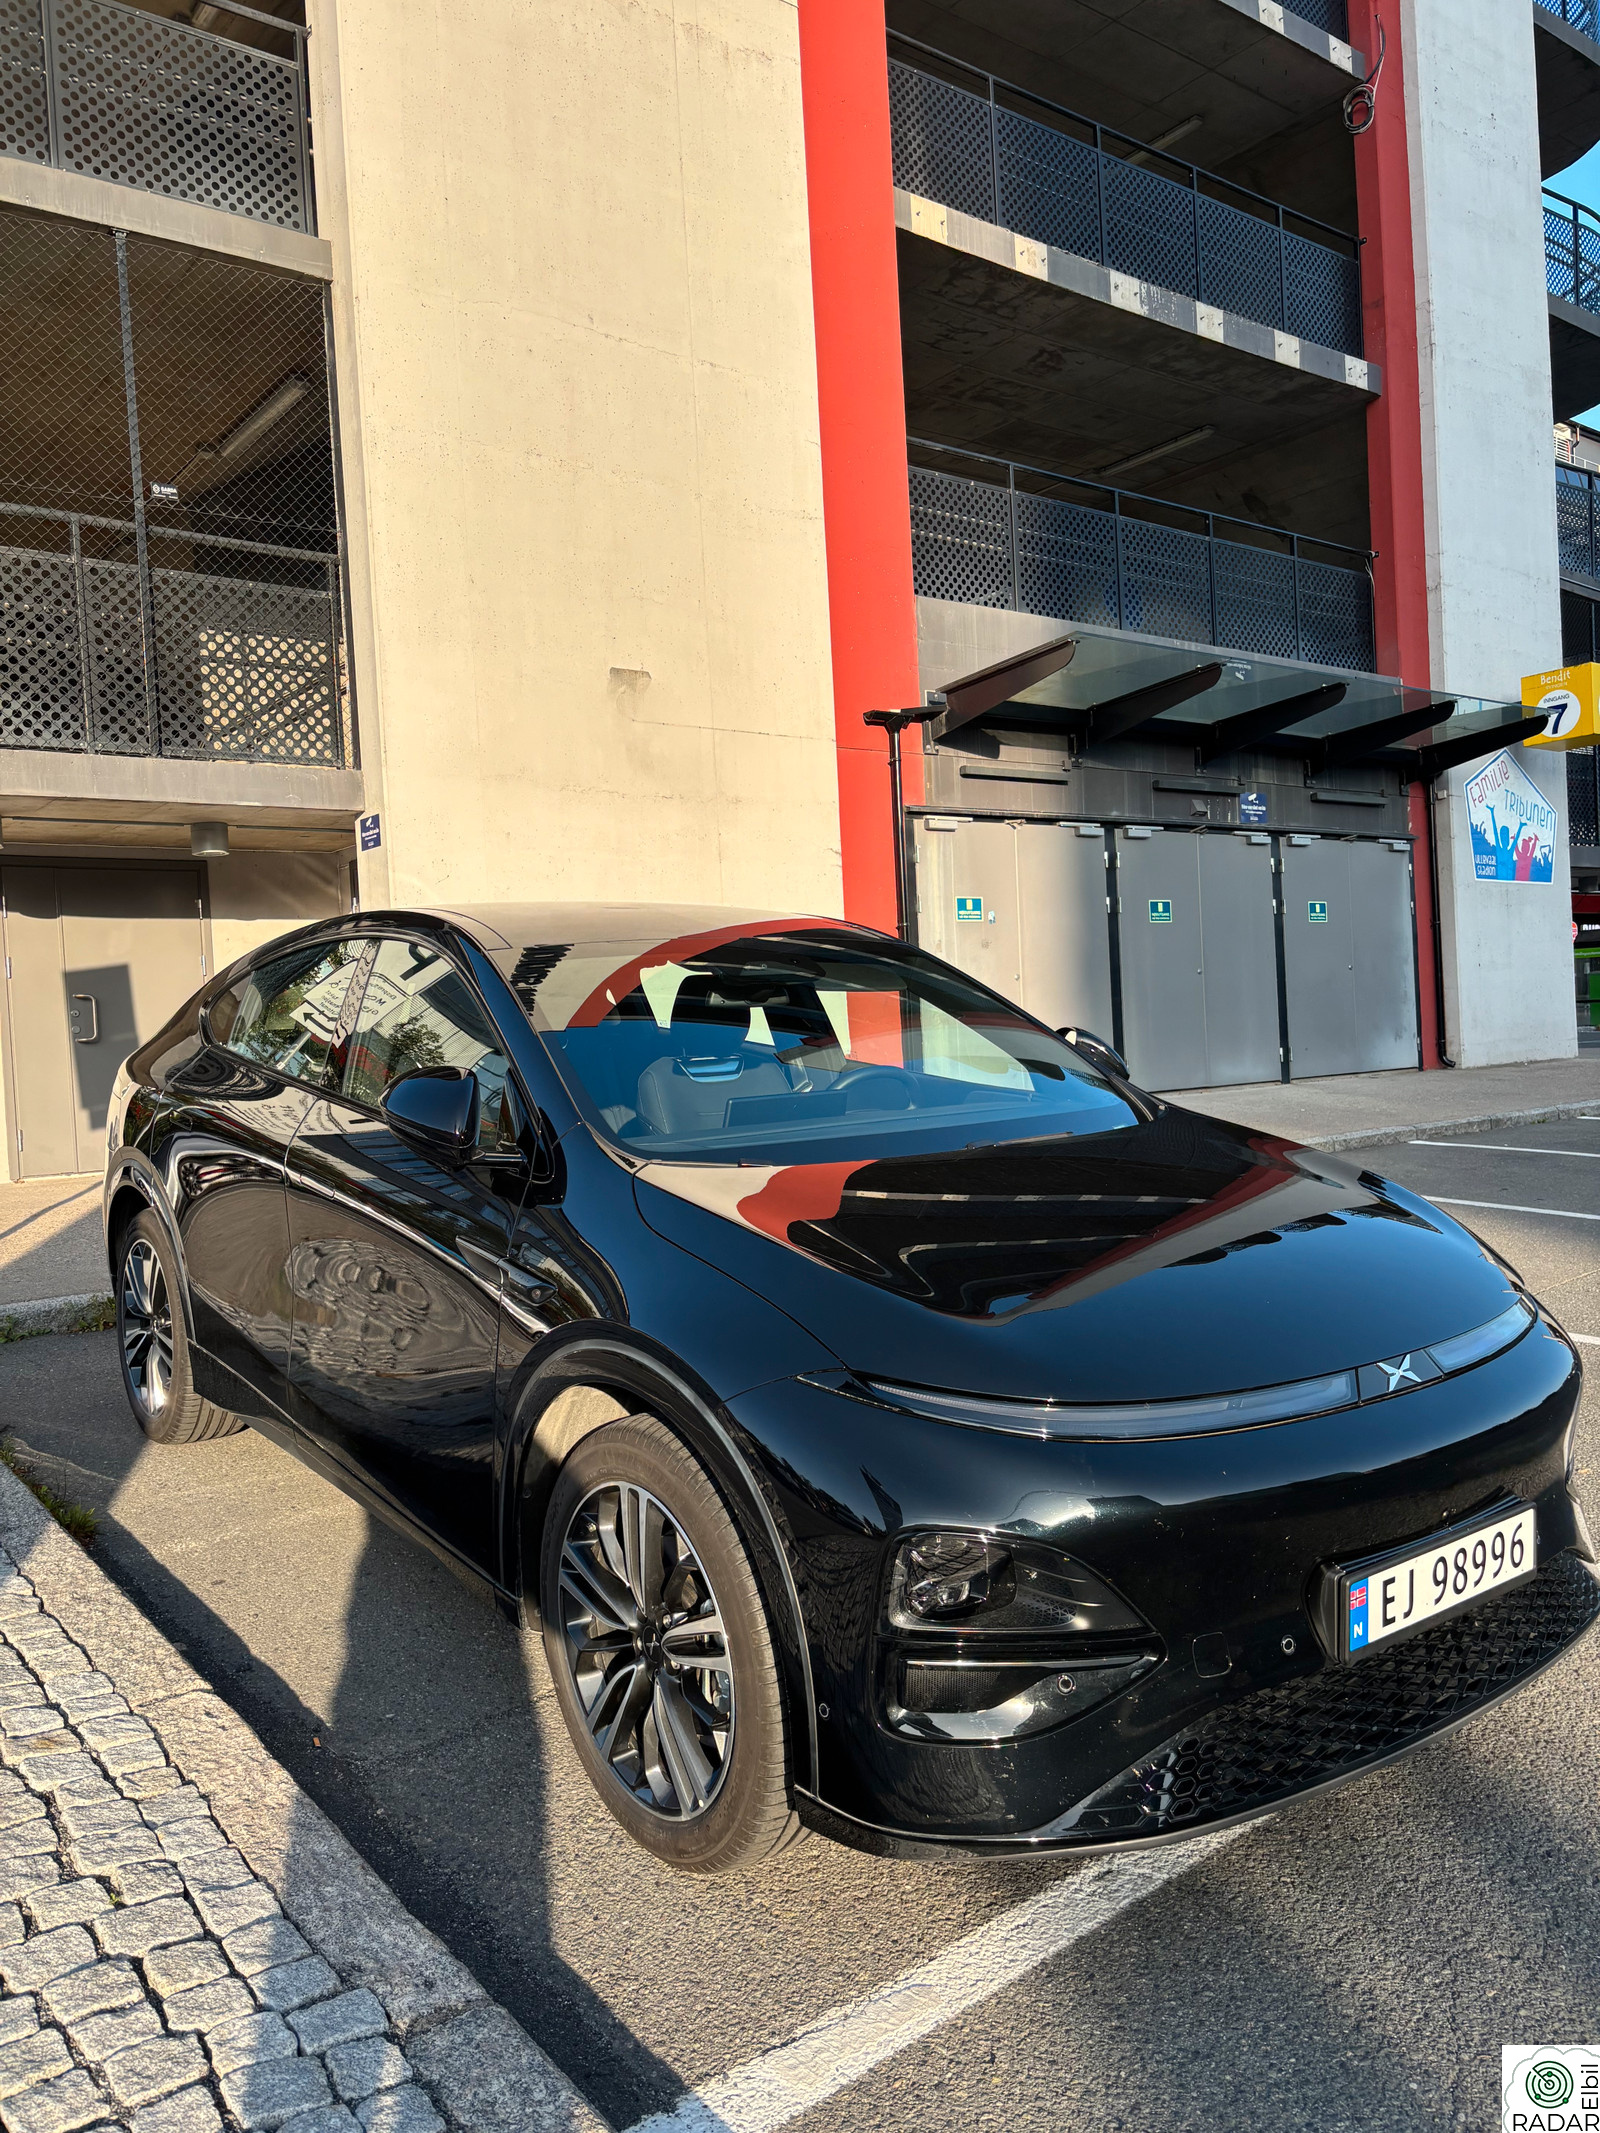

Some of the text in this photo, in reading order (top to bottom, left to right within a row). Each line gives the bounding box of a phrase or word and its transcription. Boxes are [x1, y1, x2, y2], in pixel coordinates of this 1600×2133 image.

[1540, 669, 1571, 685] Bendit
[1543, 693, 1570, 704] INNGANG
[1547, 702, 1568, 735] 7
[1382, 1522, 1524, 1628] EJ 98996
[1353, 1621, 1363, 1639] N
